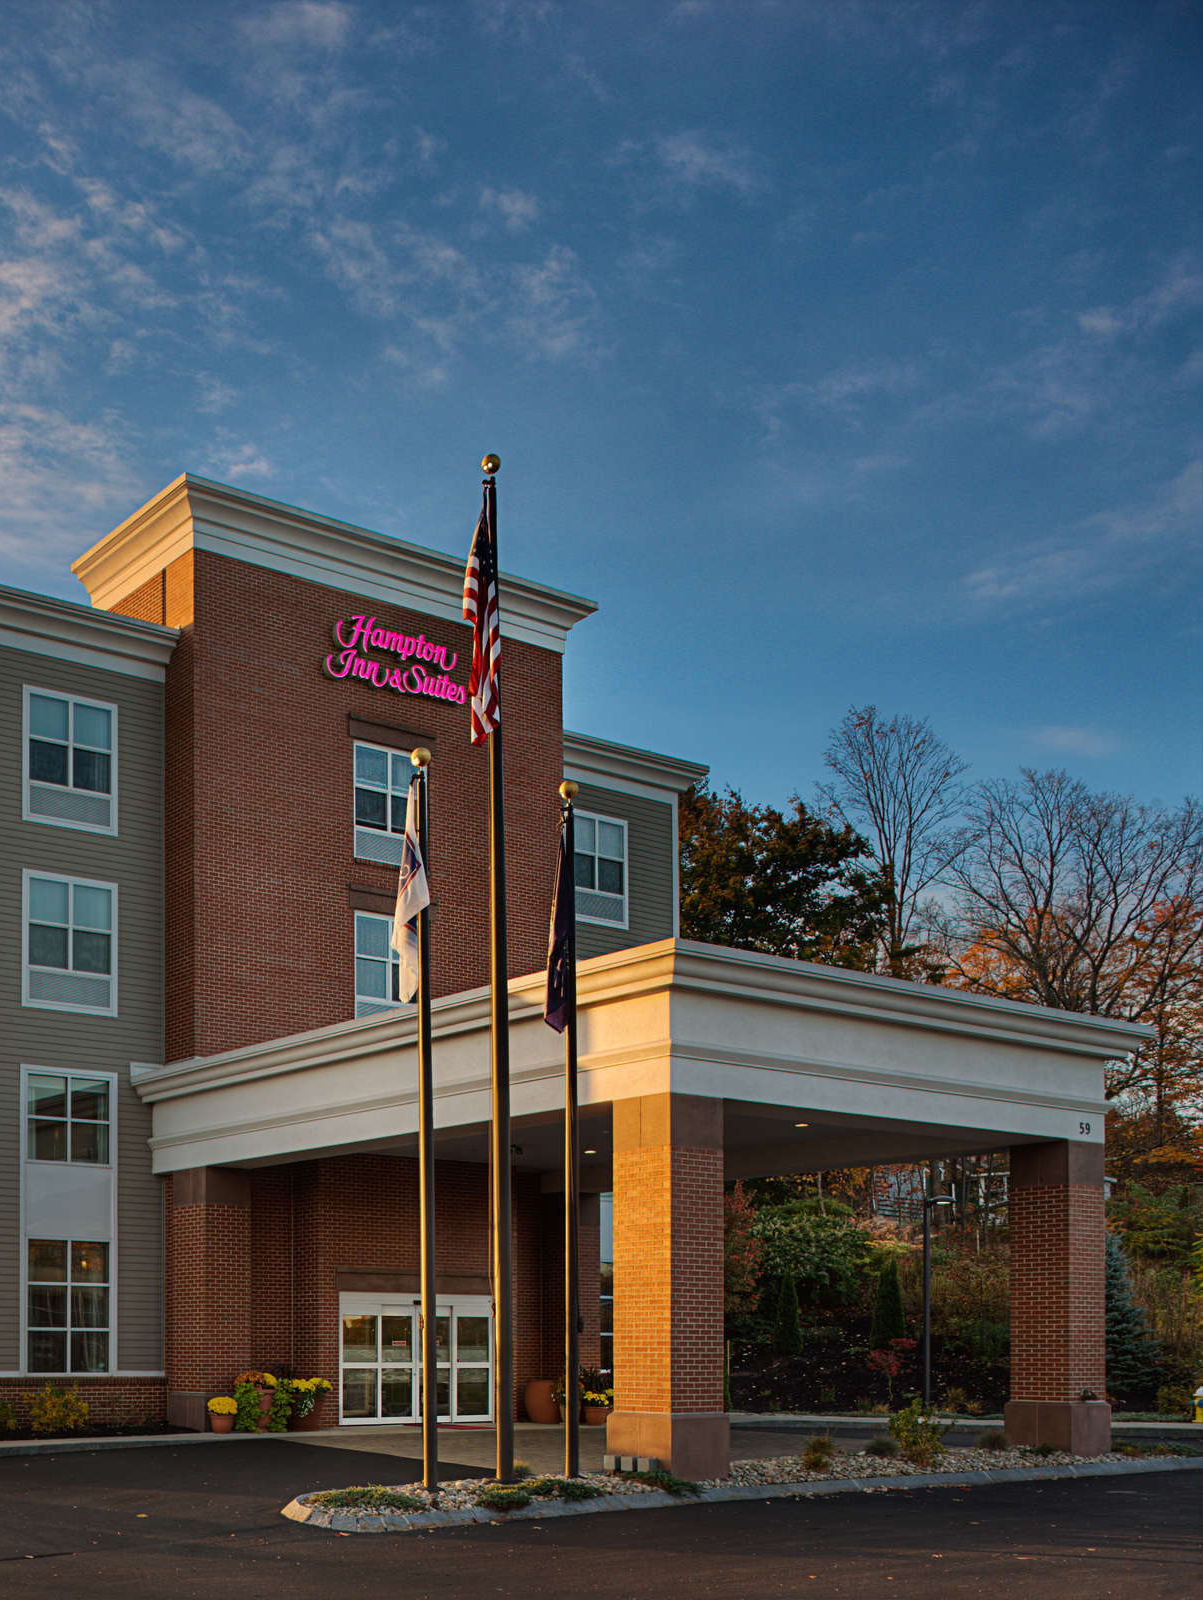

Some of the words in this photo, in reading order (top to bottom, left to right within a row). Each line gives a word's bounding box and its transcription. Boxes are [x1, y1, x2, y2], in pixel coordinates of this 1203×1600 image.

[336, 614, 458, 671] Hampton
[326, 648, 391, 687] Inn
[389, 668, 406, 692] &
[403, 664, 467, 704] Suites
[1079, 1122, 1091, 1135] 59
